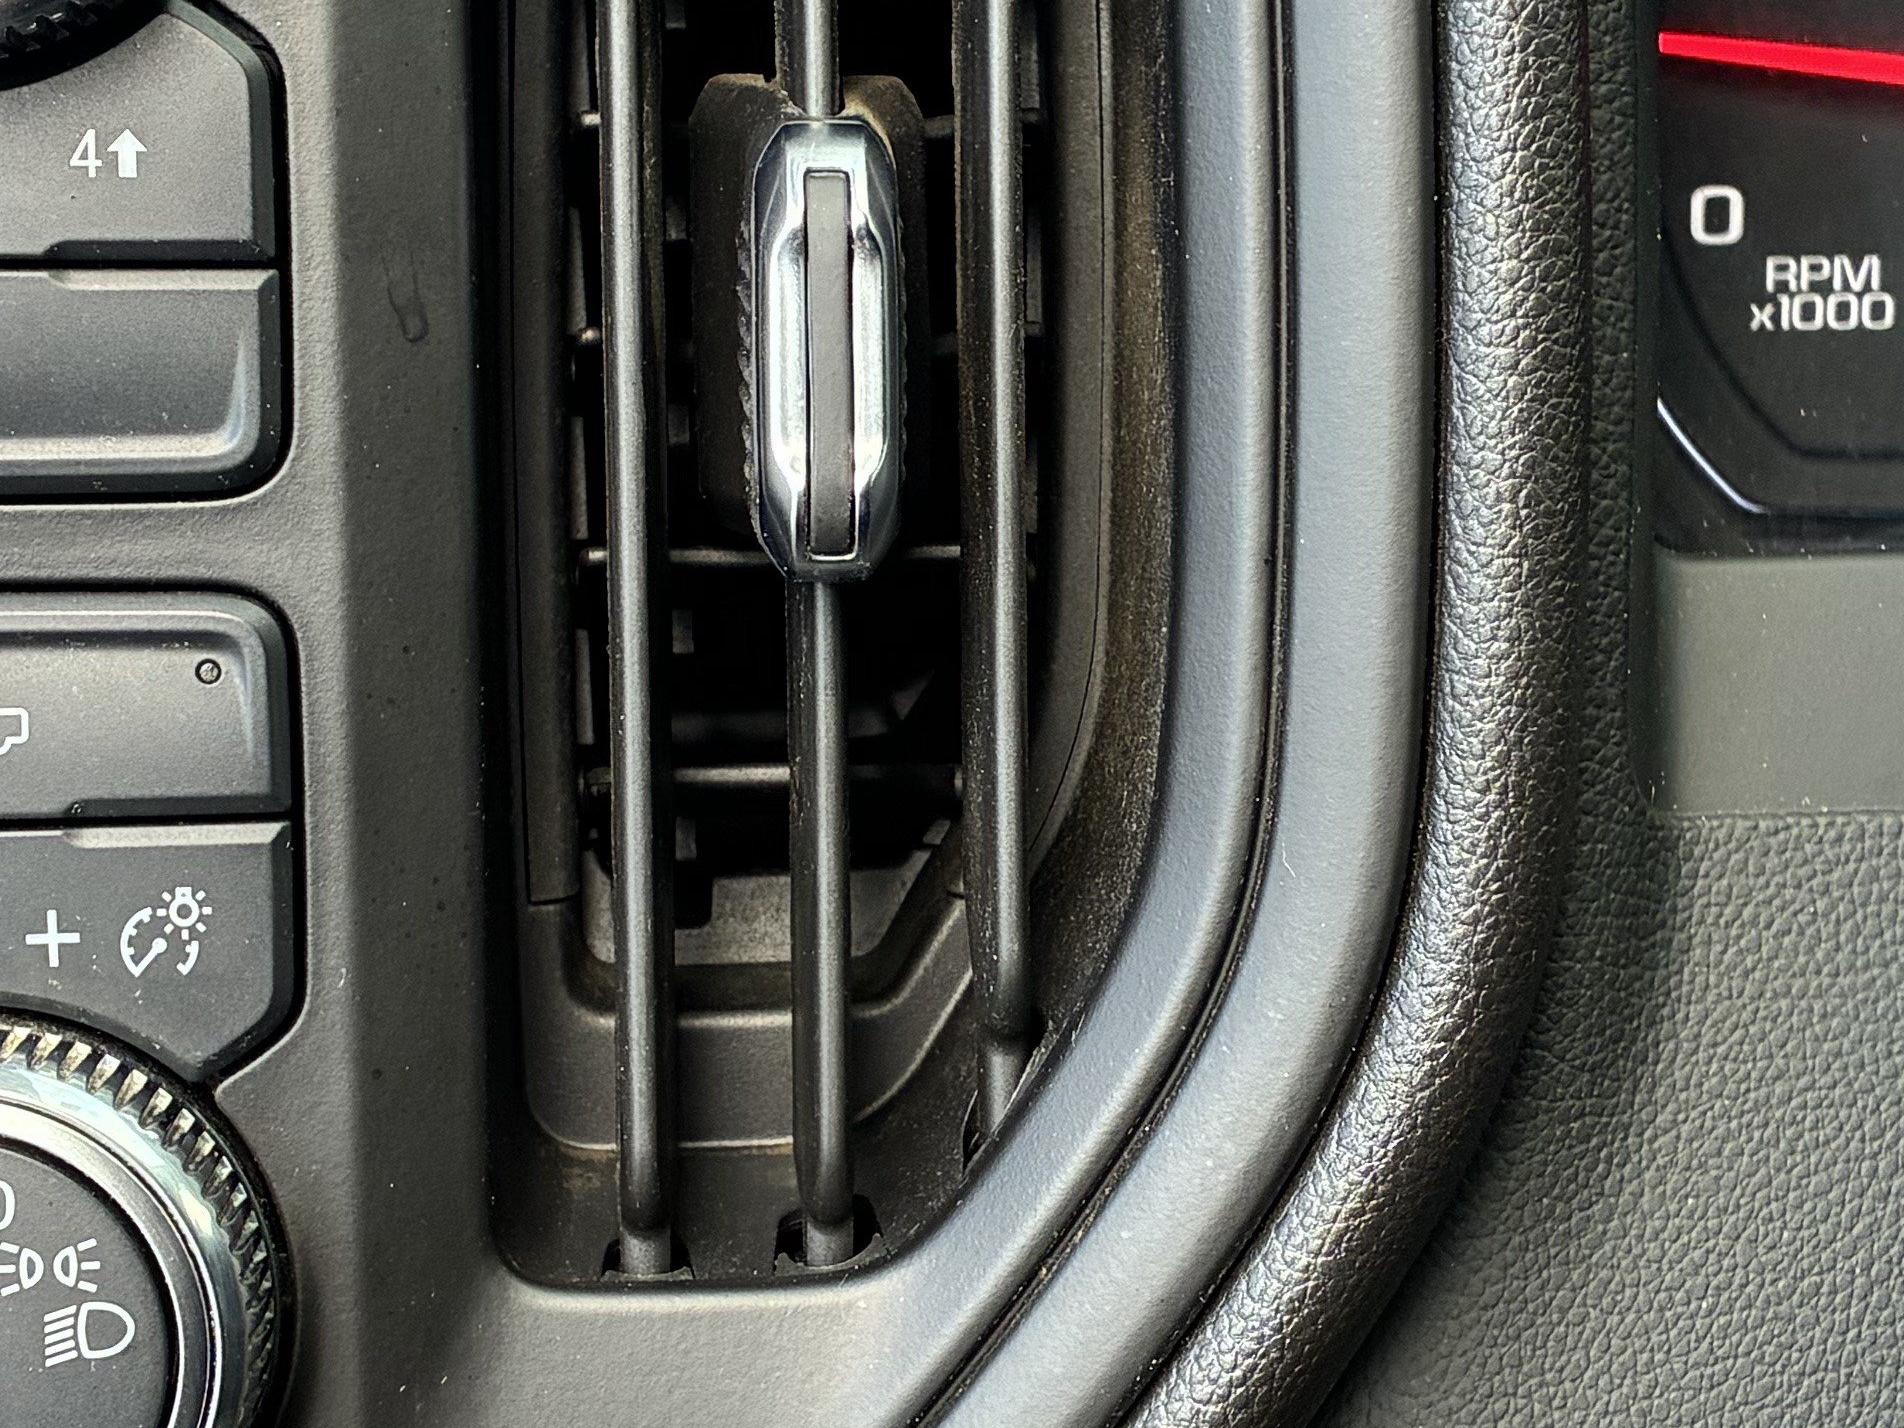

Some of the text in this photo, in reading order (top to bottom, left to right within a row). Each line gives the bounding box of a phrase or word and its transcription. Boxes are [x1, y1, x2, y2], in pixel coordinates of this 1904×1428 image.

[69, 128, 103, 179] 4
[1690, 185, 1744, 246] 0
[1765, 254, 1881, 293] RPM
[1750, 291, 1895, 331] x1000
